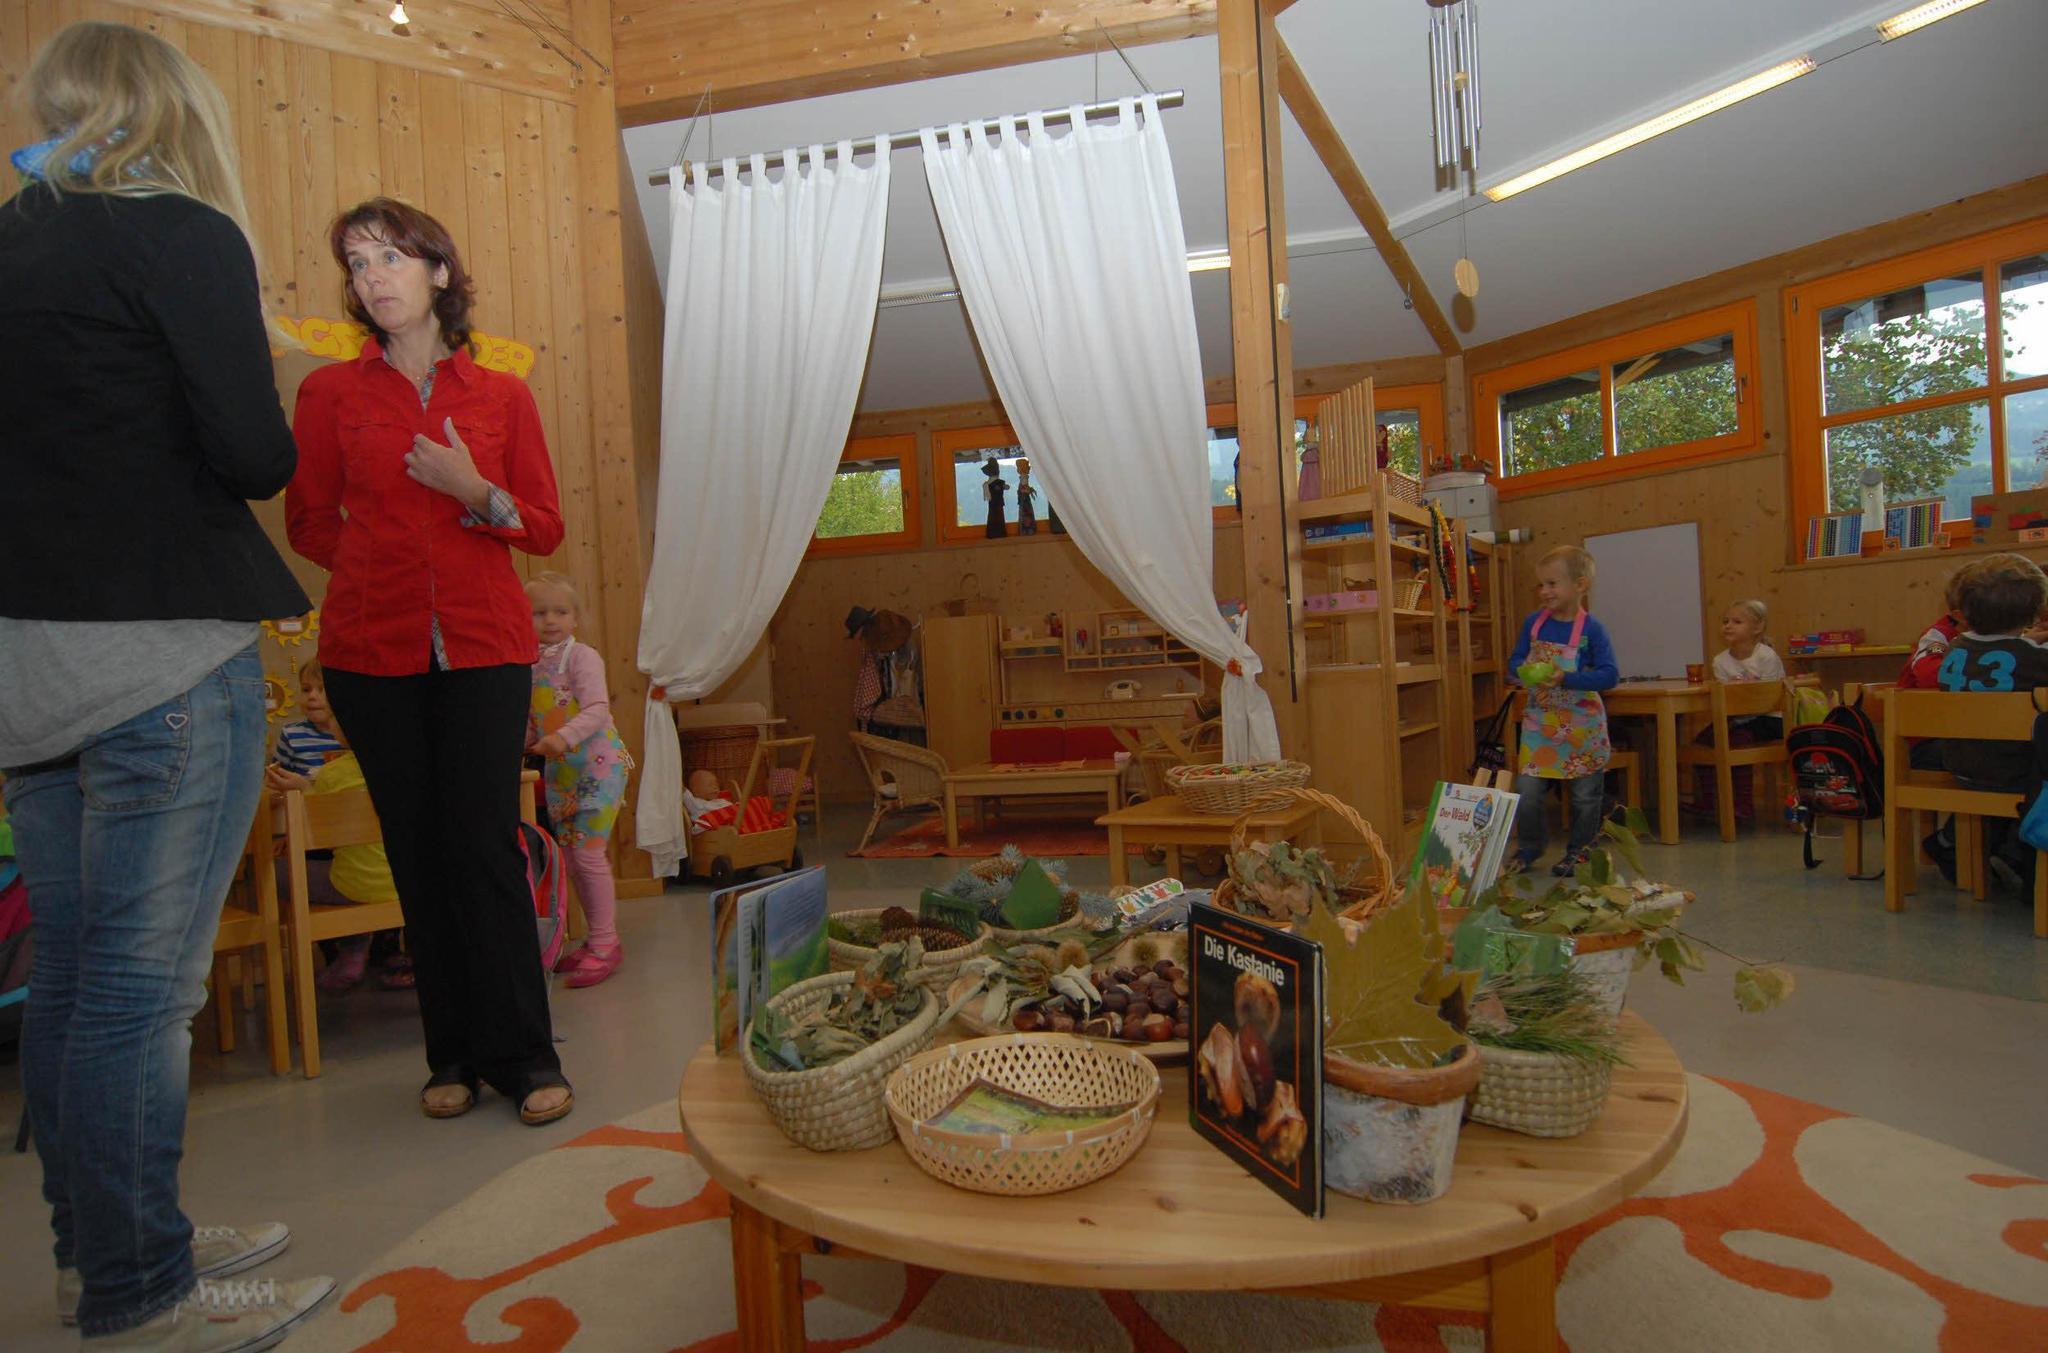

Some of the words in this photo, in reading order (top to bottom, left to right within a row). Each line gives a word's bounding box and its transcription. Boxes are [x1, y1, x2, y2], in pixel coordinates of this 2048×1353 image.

[1938, 647, 2016, 692] 43
[1439, 807, 1451, 818] Der
[1451, 807, 1472, 822] Wald
[1204, 934, 1225, 961] Die
[1227, 943, 1285, 987] Kastanie
